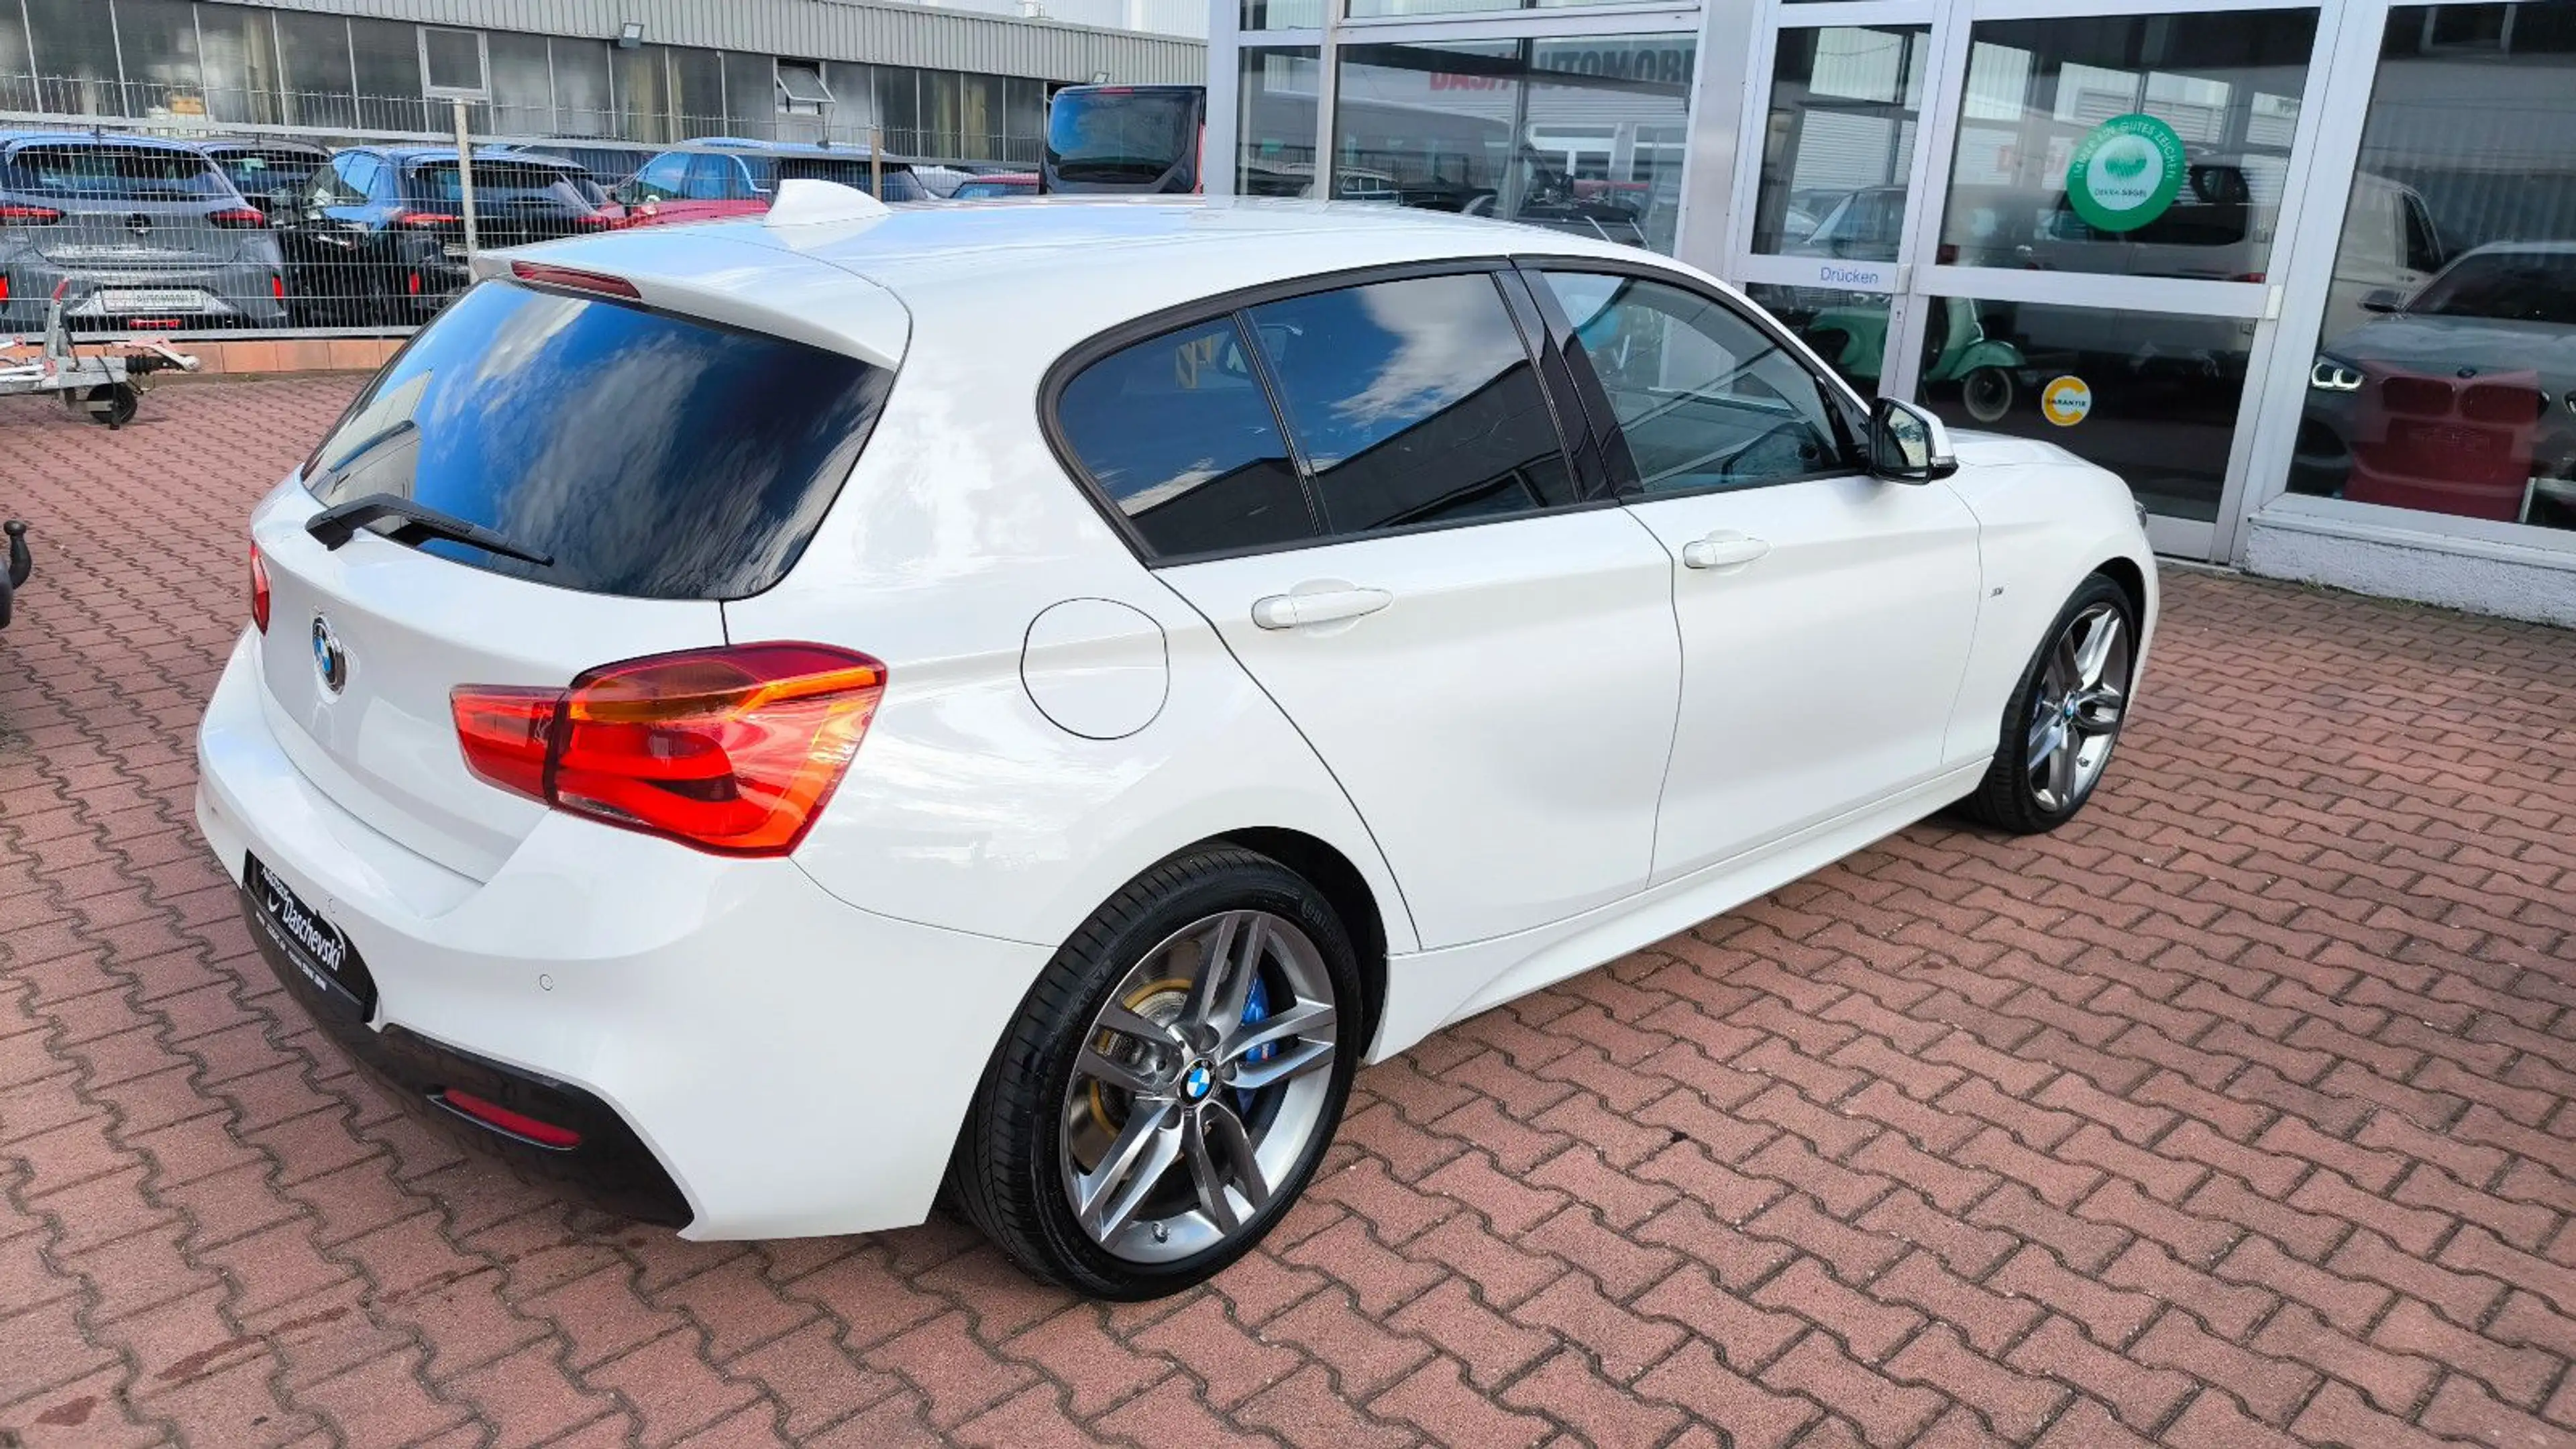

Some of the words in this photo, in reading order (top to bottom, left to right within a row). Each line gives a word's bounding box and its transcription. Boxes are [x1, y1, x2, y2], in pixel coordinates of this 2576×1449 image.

[2120, 120, 2155, 134] GUTES
[2155, 131, 2178, 179] ZEICHEN
[1821, 266, 1878, 284] Drücken
[282, 896, 343, 972] Daschevski
